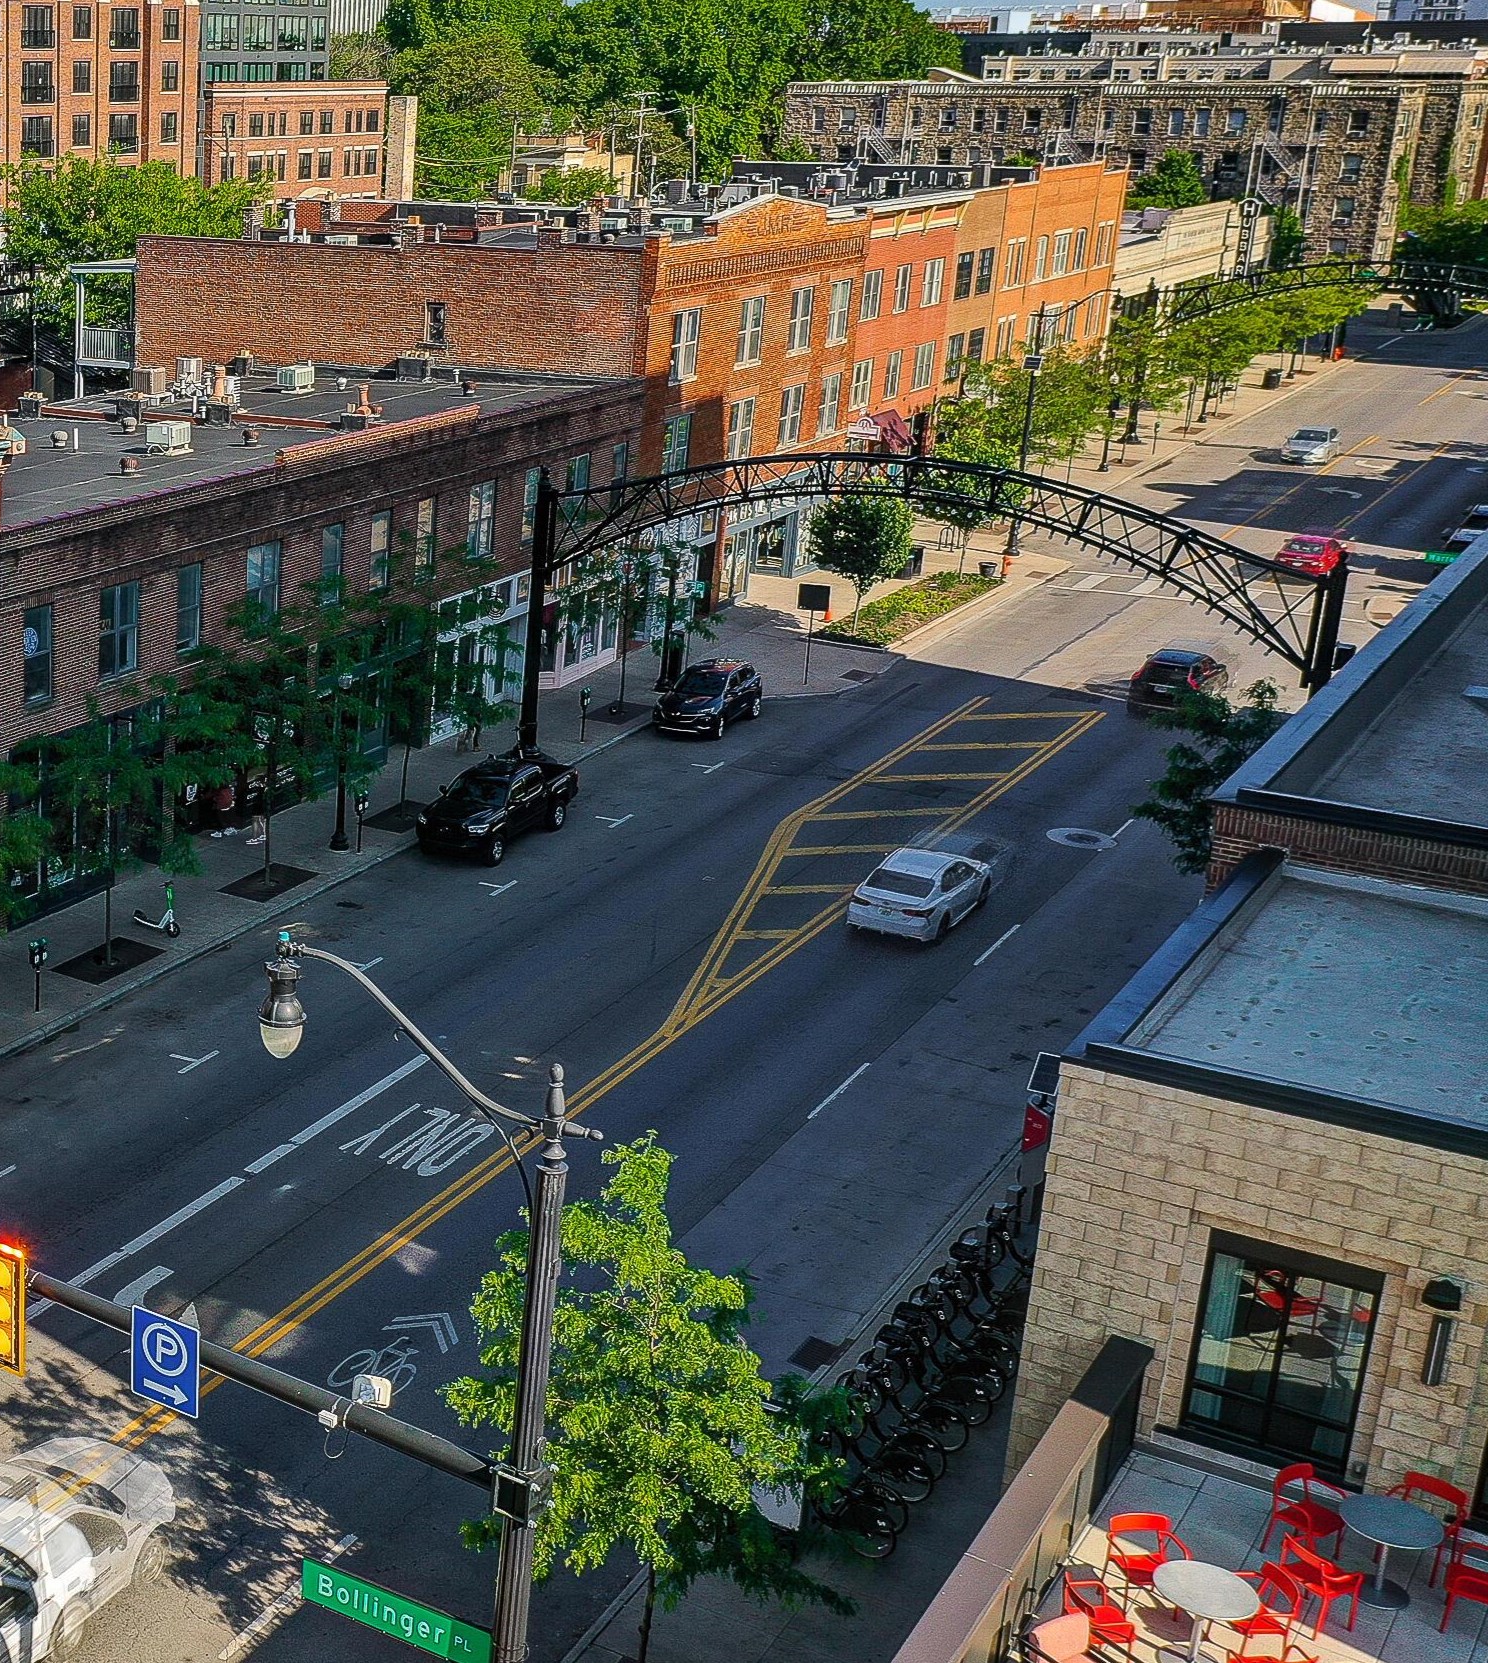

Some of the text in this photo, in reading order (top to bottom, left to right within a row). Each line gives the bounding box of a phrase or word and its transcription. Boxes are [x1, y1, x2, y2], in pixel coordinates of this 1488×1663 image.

[338, 1103, 495, 1177] ONLY
[156, 1332, 178, 1363] P
[317, 1573, 472, 1653] Bollinger PL
